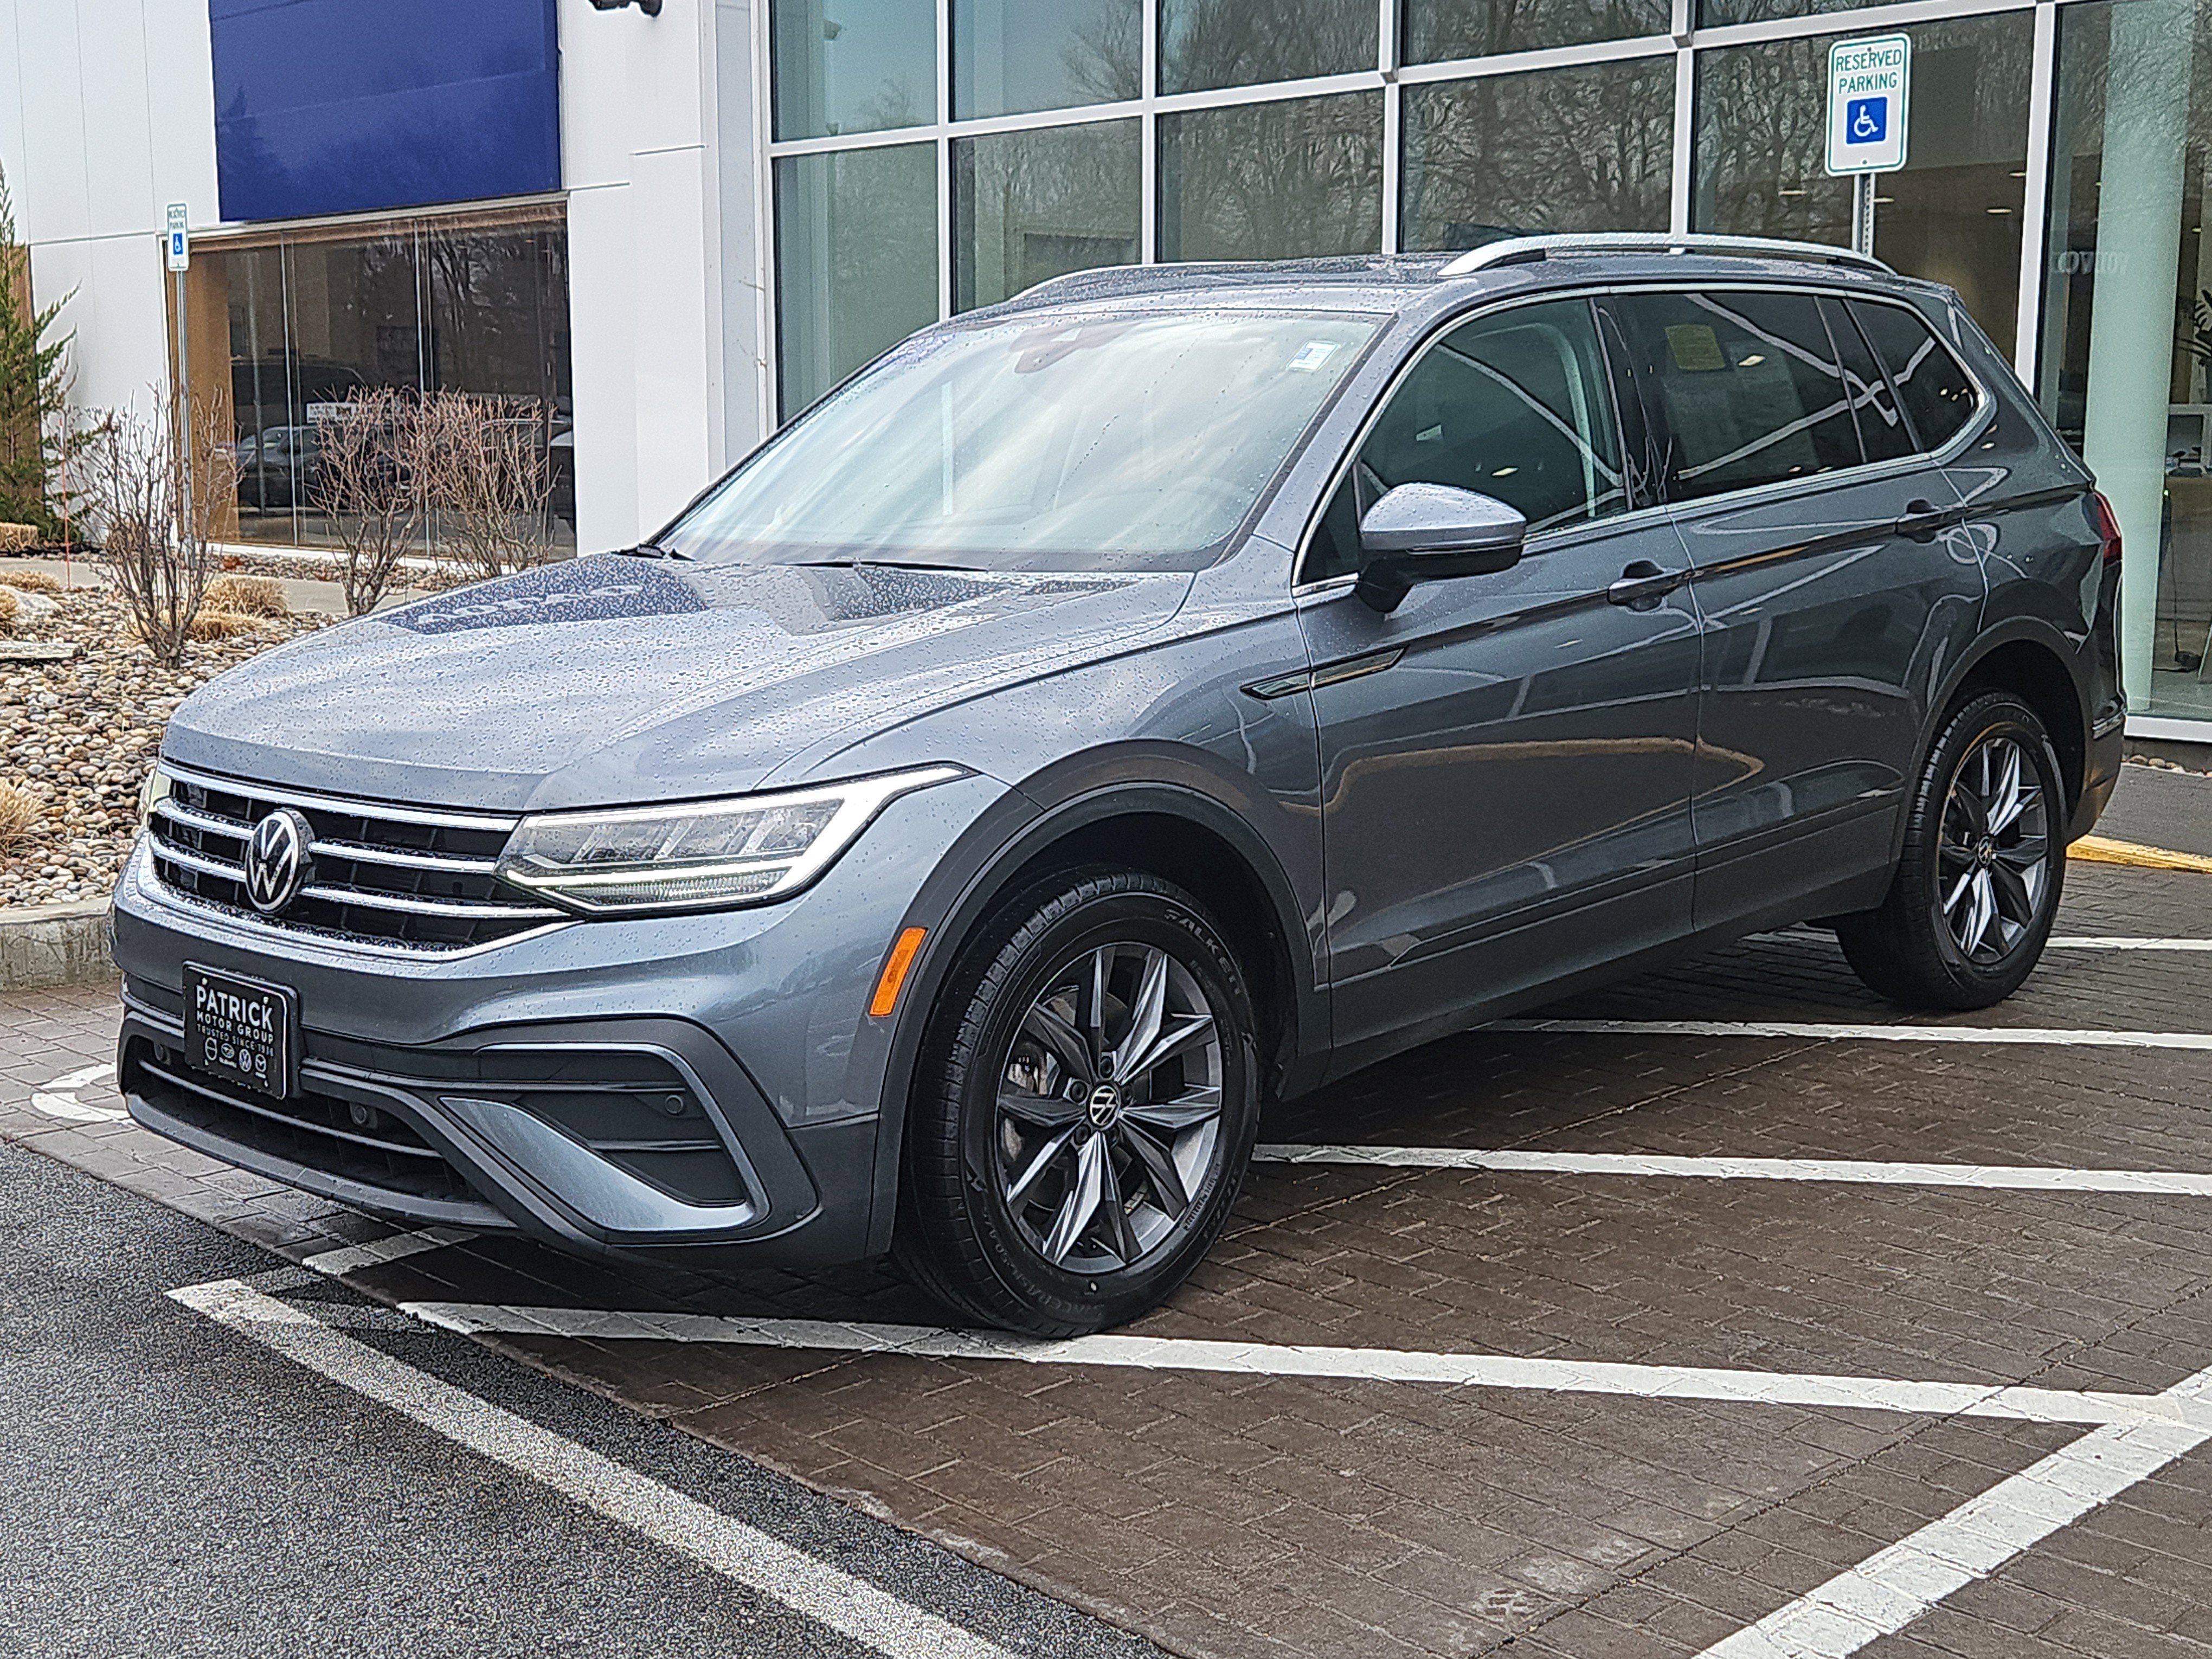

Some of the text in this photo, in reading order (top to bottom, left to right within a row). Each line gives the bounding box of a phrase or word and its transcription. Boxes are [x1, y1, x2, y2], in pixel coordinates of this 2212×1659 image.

[1836, 48, 1902, 72] RESERVED
[1838, 72, 1898, 94] PARKING
[196, 985, 273, 1032] PATRICK
[197, 1011, 273, 1044] MOTOR GROUP
[197, 1024, 230, 1041] TRUSTED
[232, 1036, 255, 1051] SINCE
